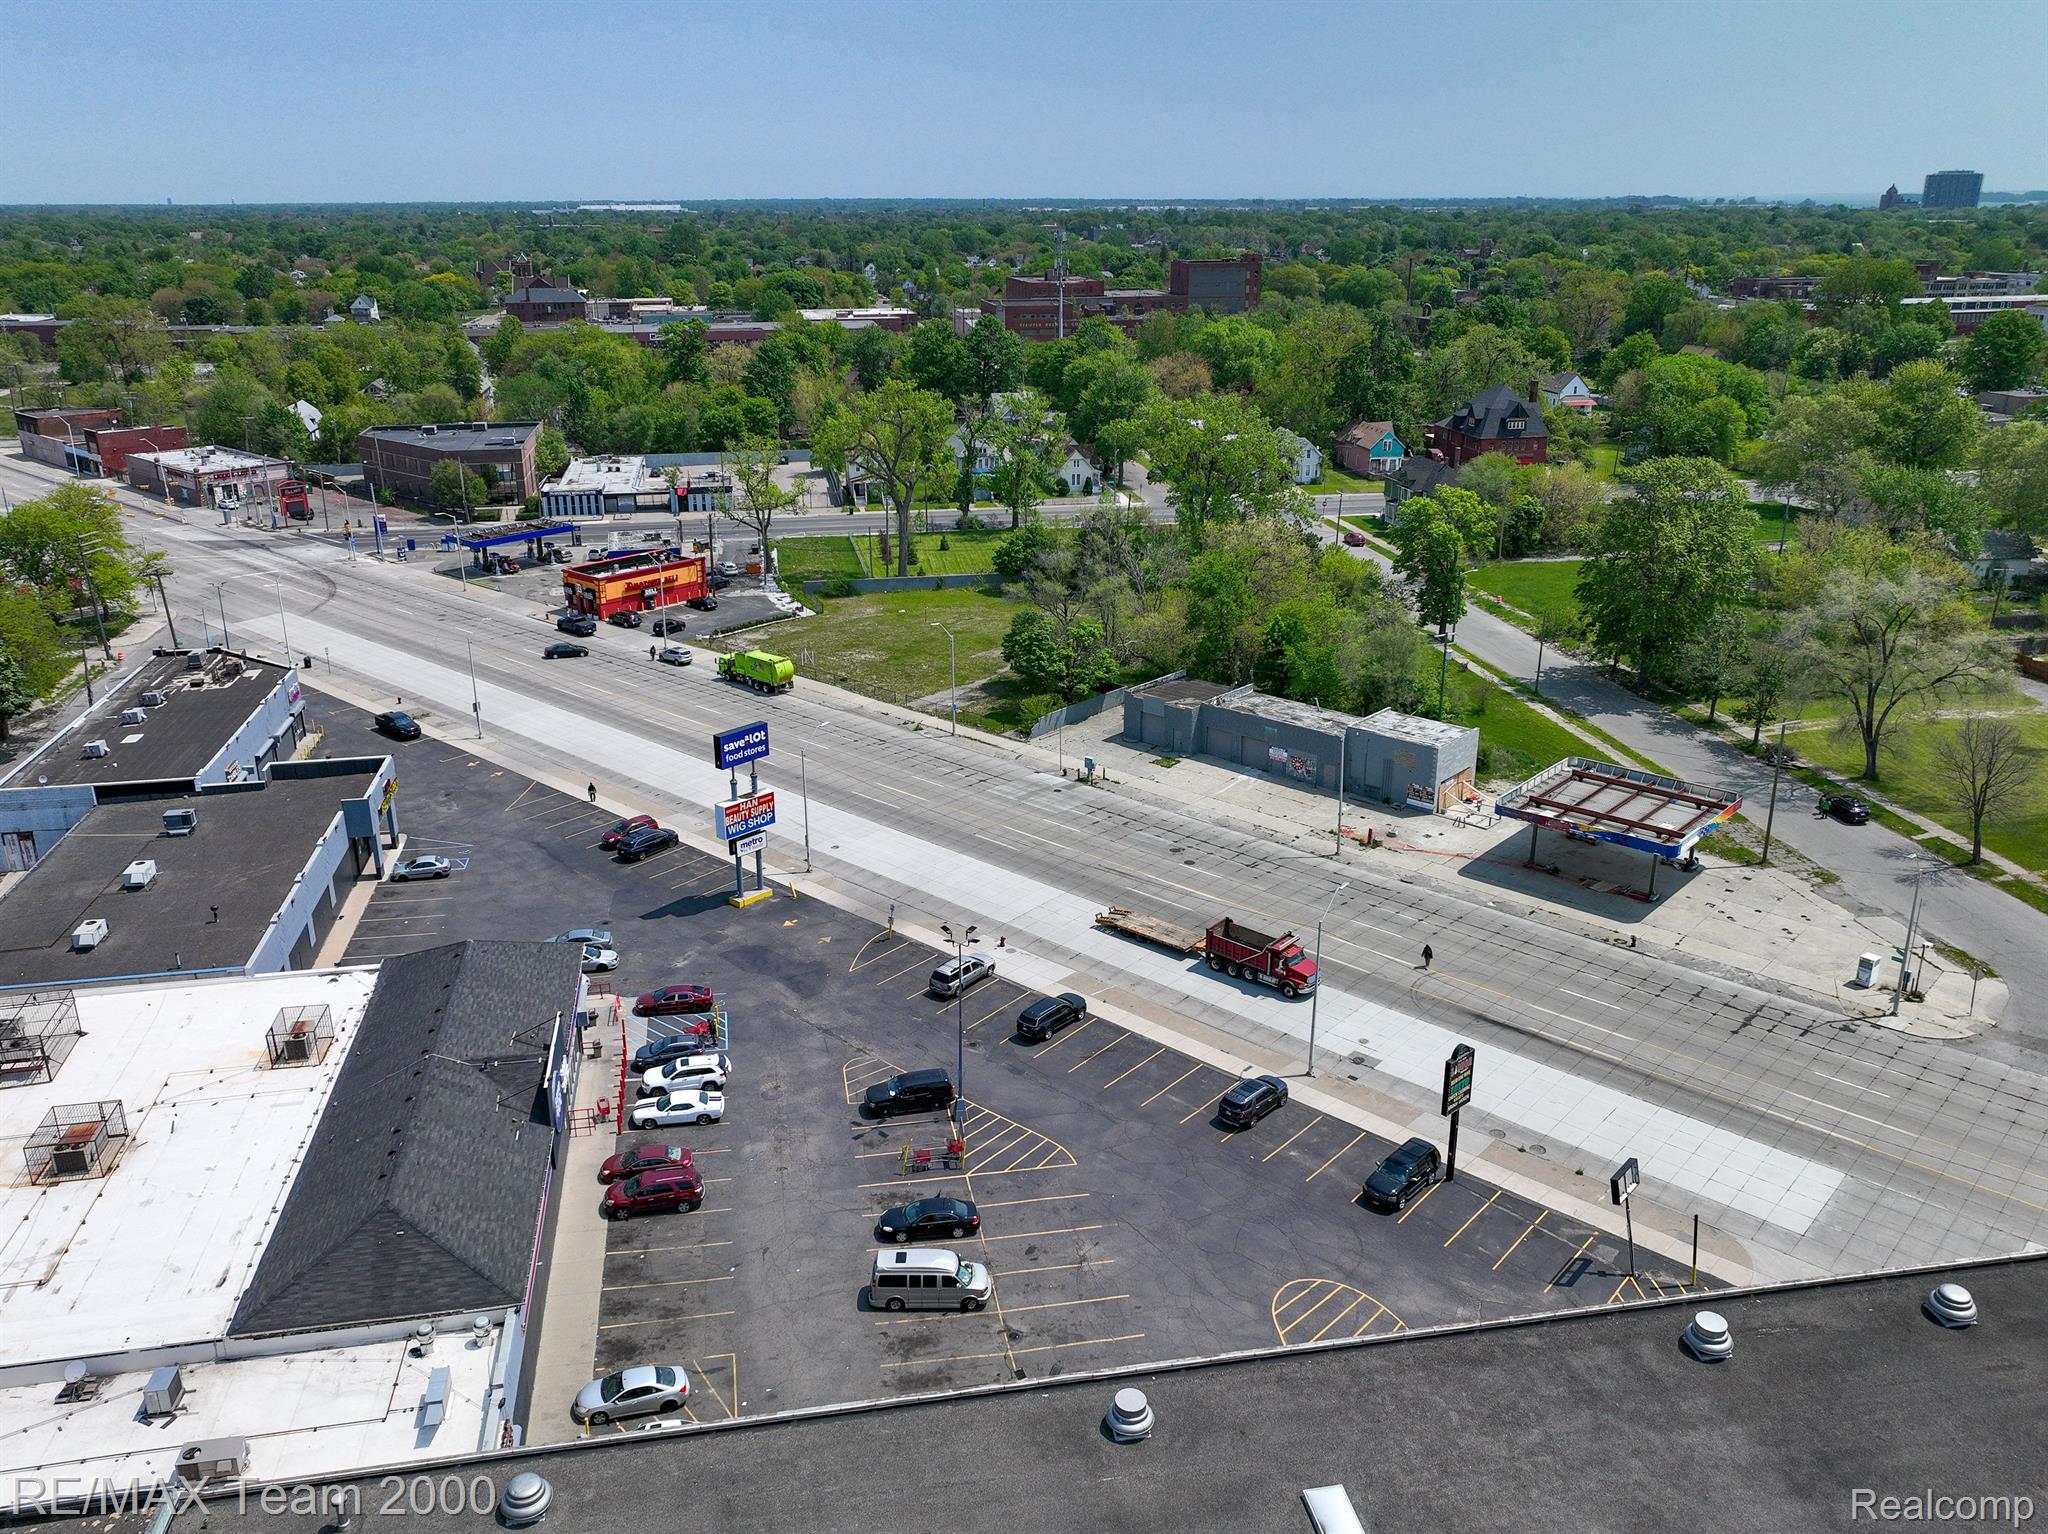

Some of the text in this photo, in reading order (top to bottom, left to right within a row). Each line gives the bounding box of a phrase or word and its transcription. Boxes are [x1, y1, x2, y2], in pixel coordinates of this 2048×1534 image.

[725, 744, 766, 763] food stores
[725, 801, 774, 826] BEAUTY SUPPLY
[739, 798, 759, 811] HAN
[727, 811, 773, 835] WIG SHOP
[740, 836, 763, 849] metro
